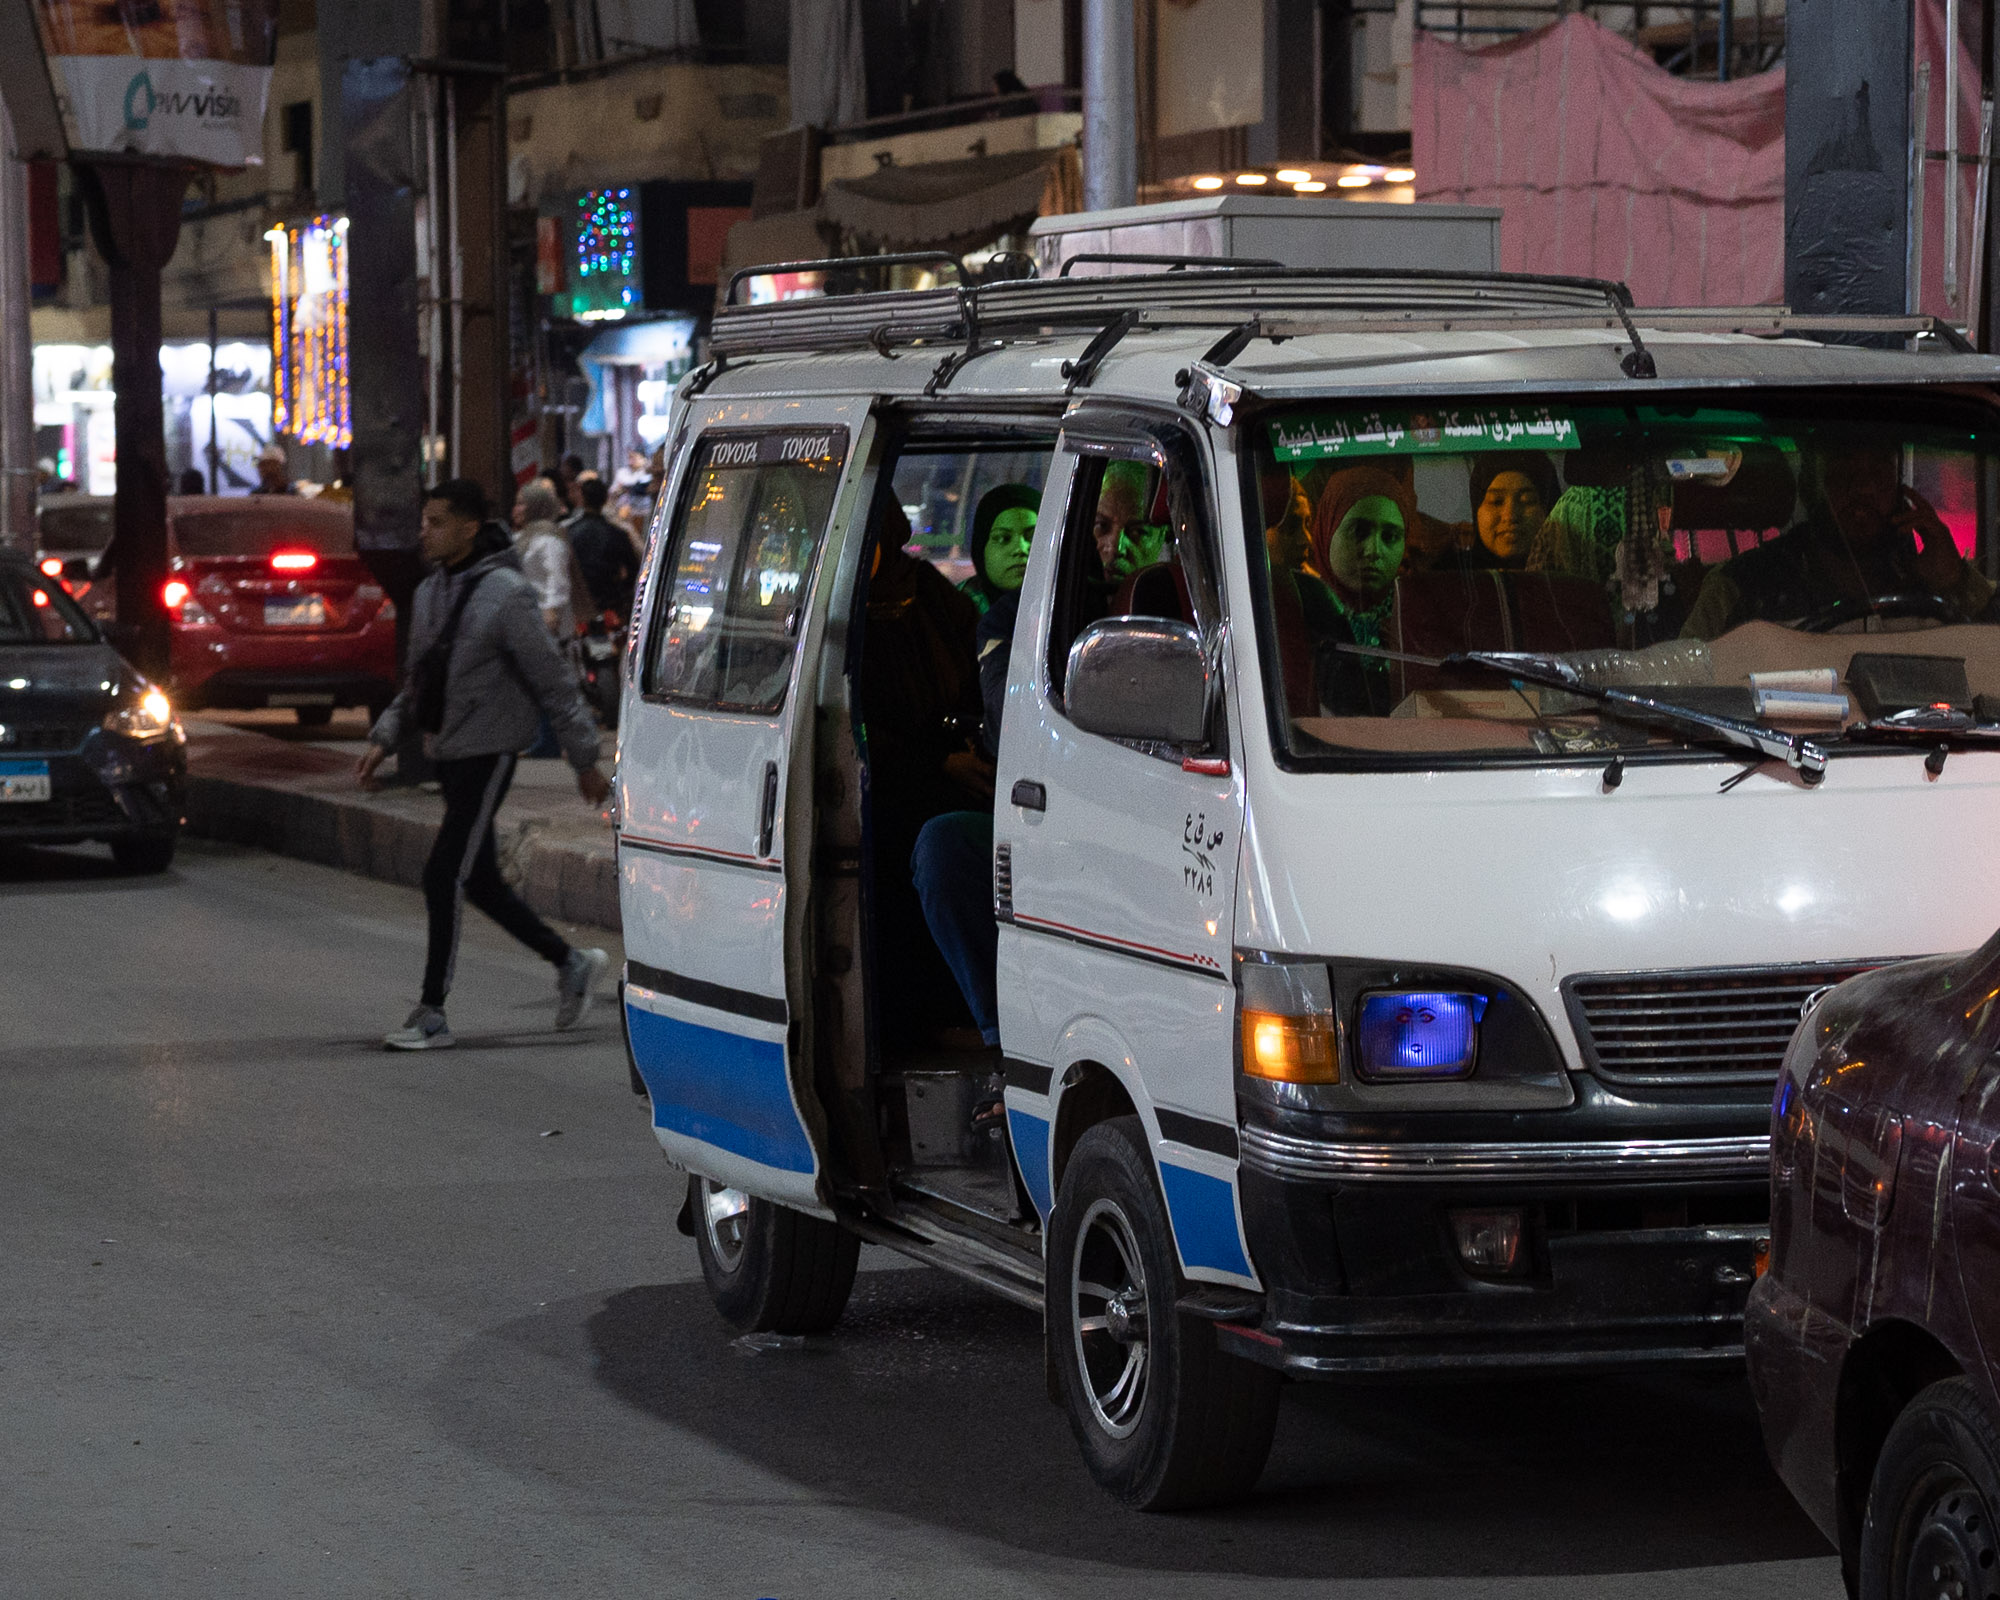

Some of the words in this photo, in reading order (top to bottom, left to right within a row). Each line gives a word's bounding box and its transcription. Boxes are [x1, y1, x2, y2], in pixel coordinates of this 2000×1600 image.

[1271, 419, 1350, 456] البياضية
[1353, 413, 1404, 448] موقف
[1438, 410, 1488, 437] السكة
[1489, 408, 1524, 442] شرق
[1525, 407, 1571, 442] موقف
[710, 441, 758, 464] TOYOTA
[780, 436, 830, 460] TOYOTA
[1183, 865, 1213, 897] ٣٢٨٩
